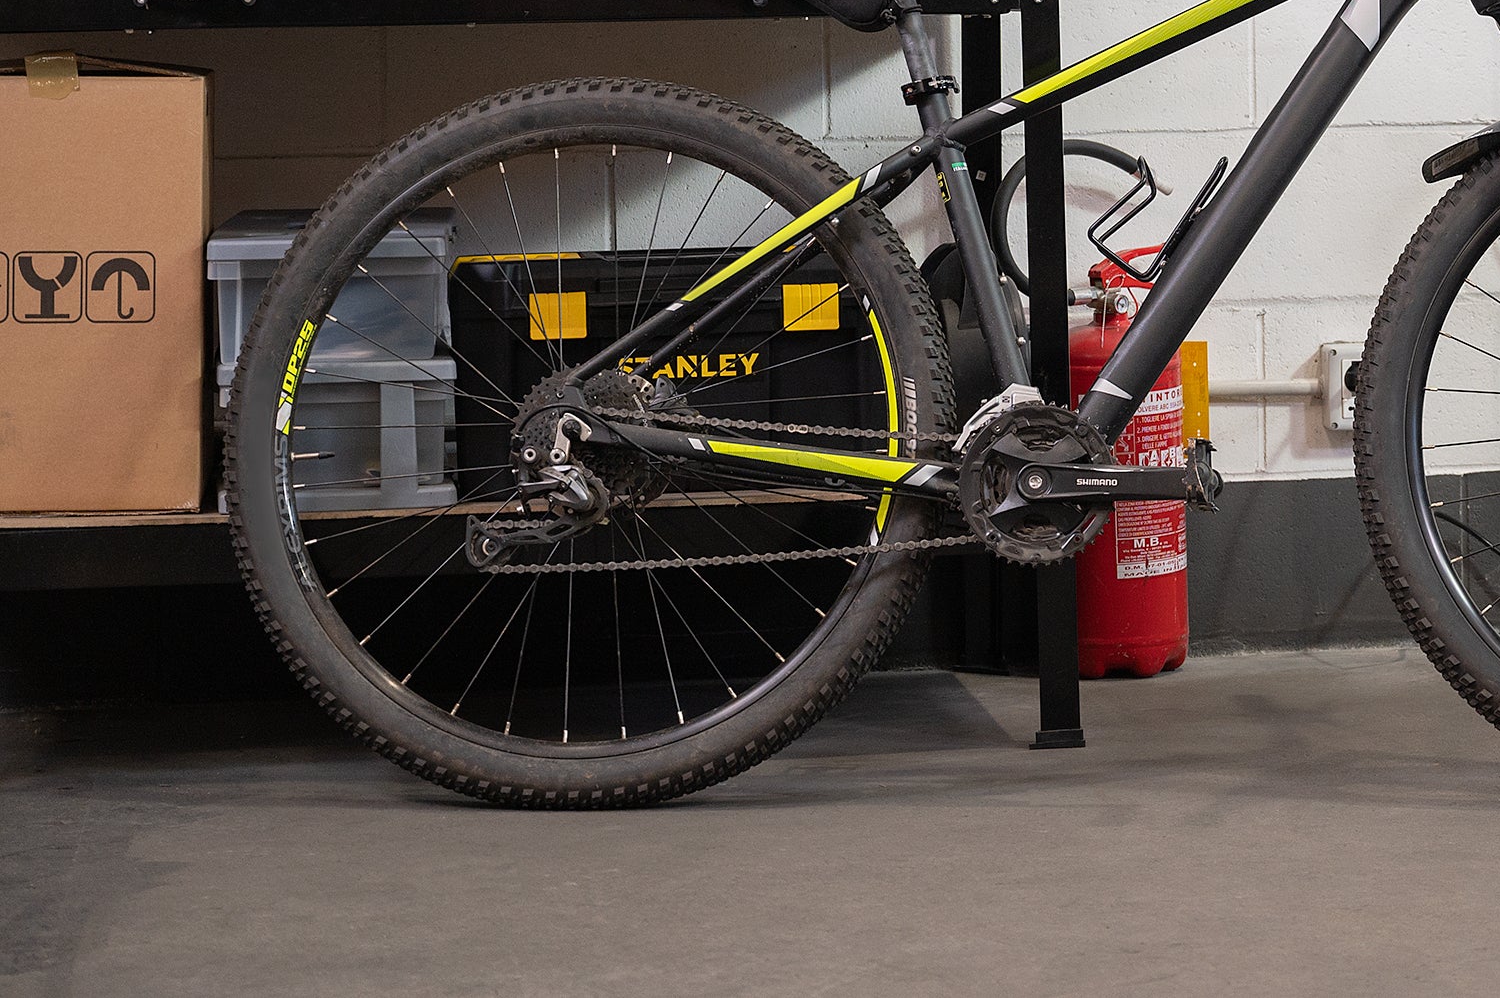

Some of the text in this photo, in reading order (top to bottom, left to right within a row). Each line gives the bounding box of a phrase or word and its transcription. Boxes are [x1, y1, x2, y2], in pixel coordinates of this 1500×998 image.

[282, 319, 314, 394] DP25
[618, 353, 759, 379] STANLEY
[1076, 478, 1118, 487] SHIMANO
[1134, 536, 1163, 549] M.B.
